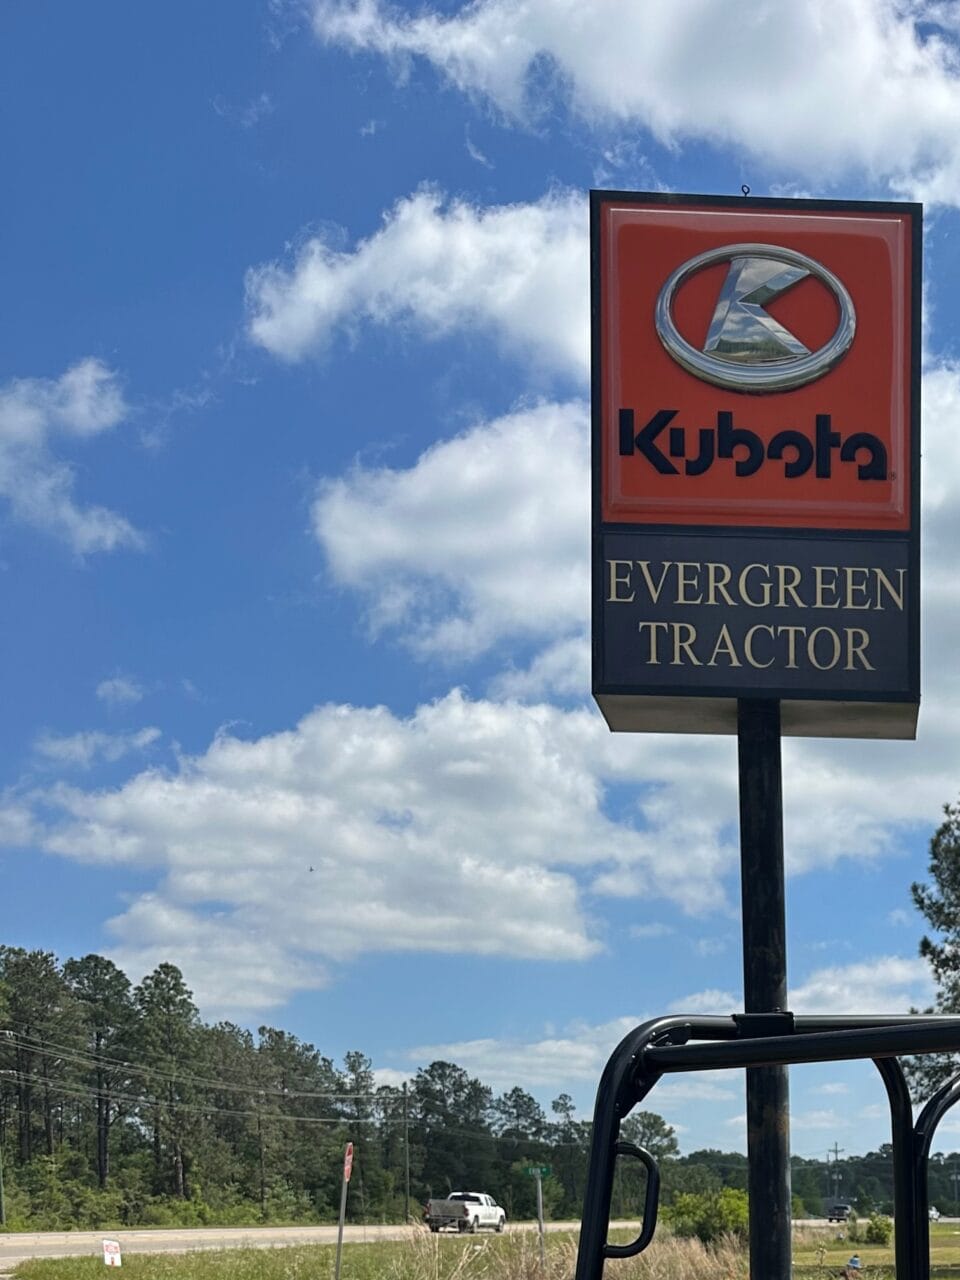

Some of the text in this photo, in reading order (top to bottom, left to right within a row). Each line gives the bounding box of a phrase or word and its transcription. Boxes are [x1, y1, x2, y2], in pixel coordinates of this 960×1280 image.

[619, 408, 888, 481] Kubota
[605, 559, 907, 611] EVERGREEN
[638, 621, 877, 672] TRACTOR
